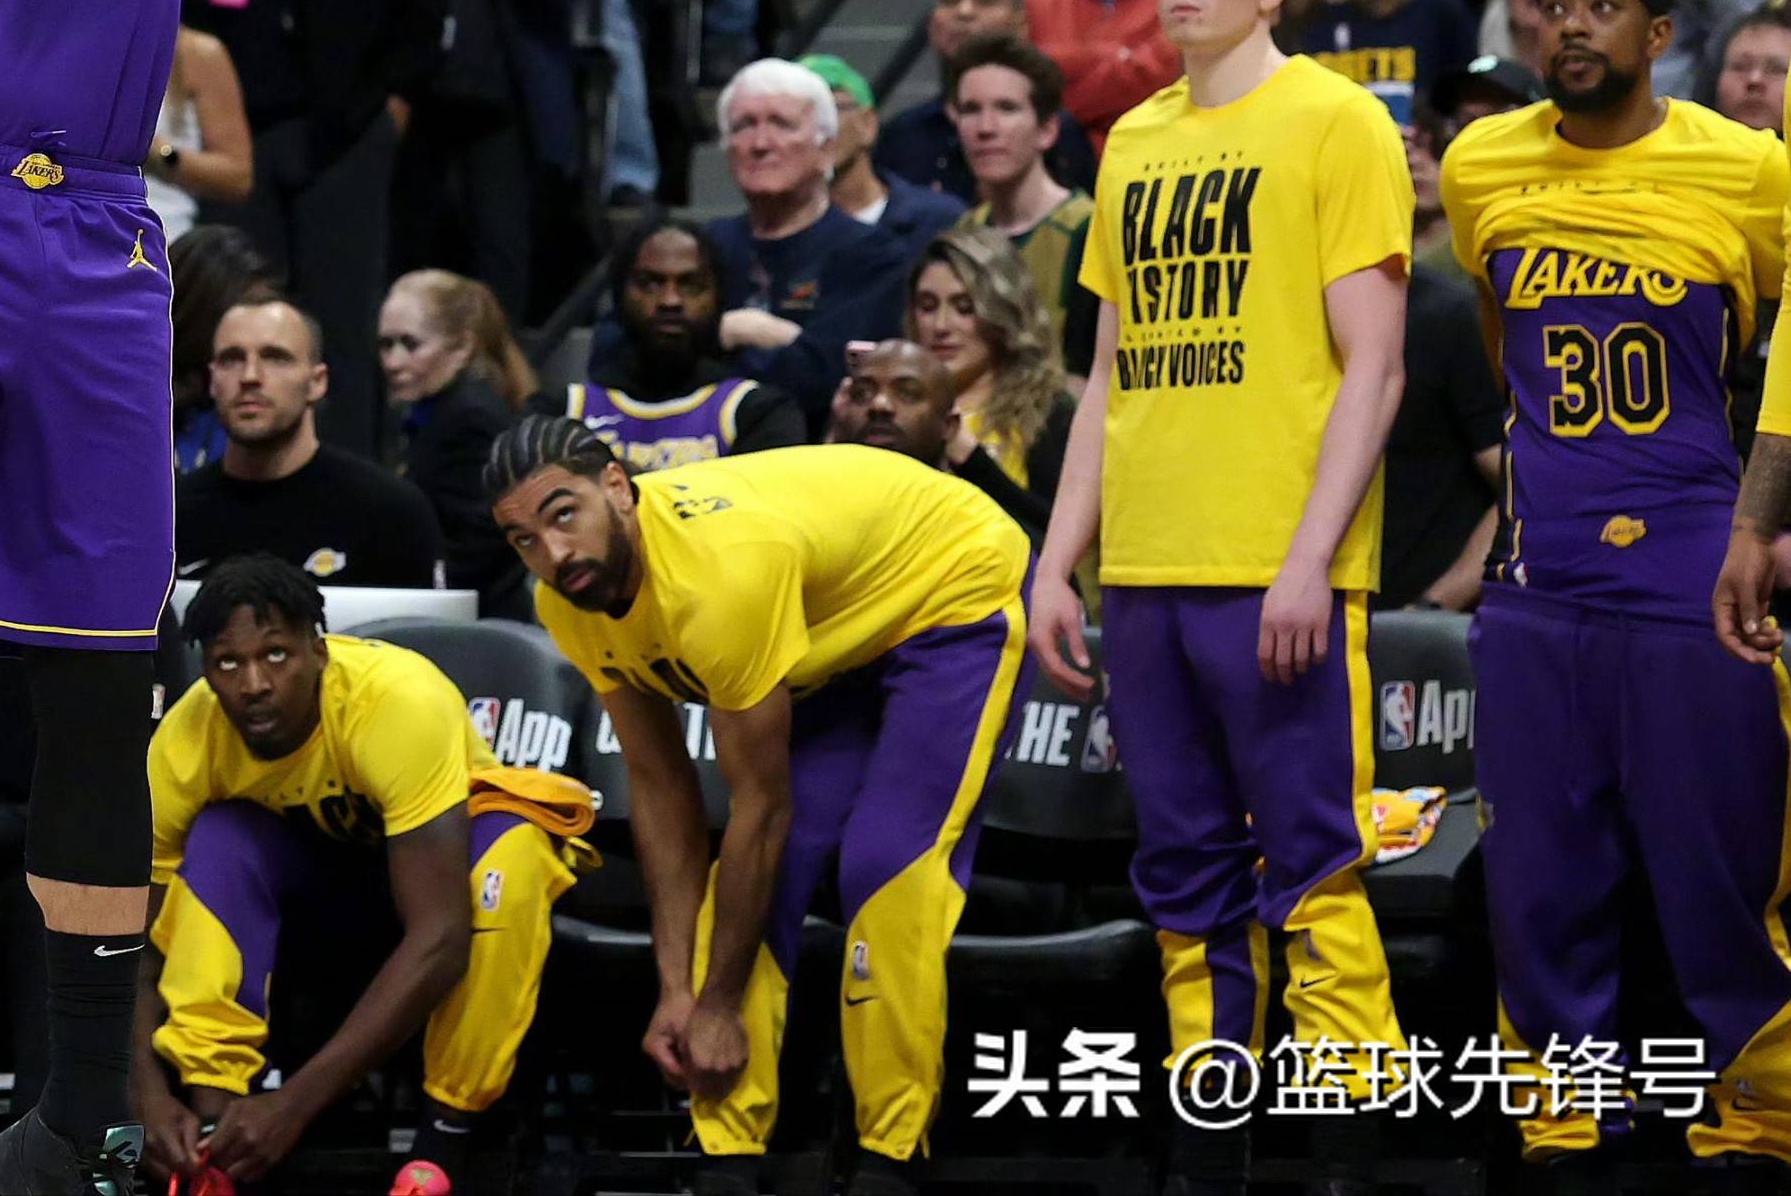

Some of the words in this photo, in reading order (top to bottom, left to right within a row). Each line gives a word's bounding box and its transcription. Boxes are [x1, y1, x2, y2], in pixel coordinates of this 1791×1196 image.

[1122, 167, 1263, 266] BLACK
[1169, 340, 1246, 387] VOICES
[1542, 322, 1670, 438] 30
[494, 698, 573, 773] App
[1005, 701, 1080, 767] HE
